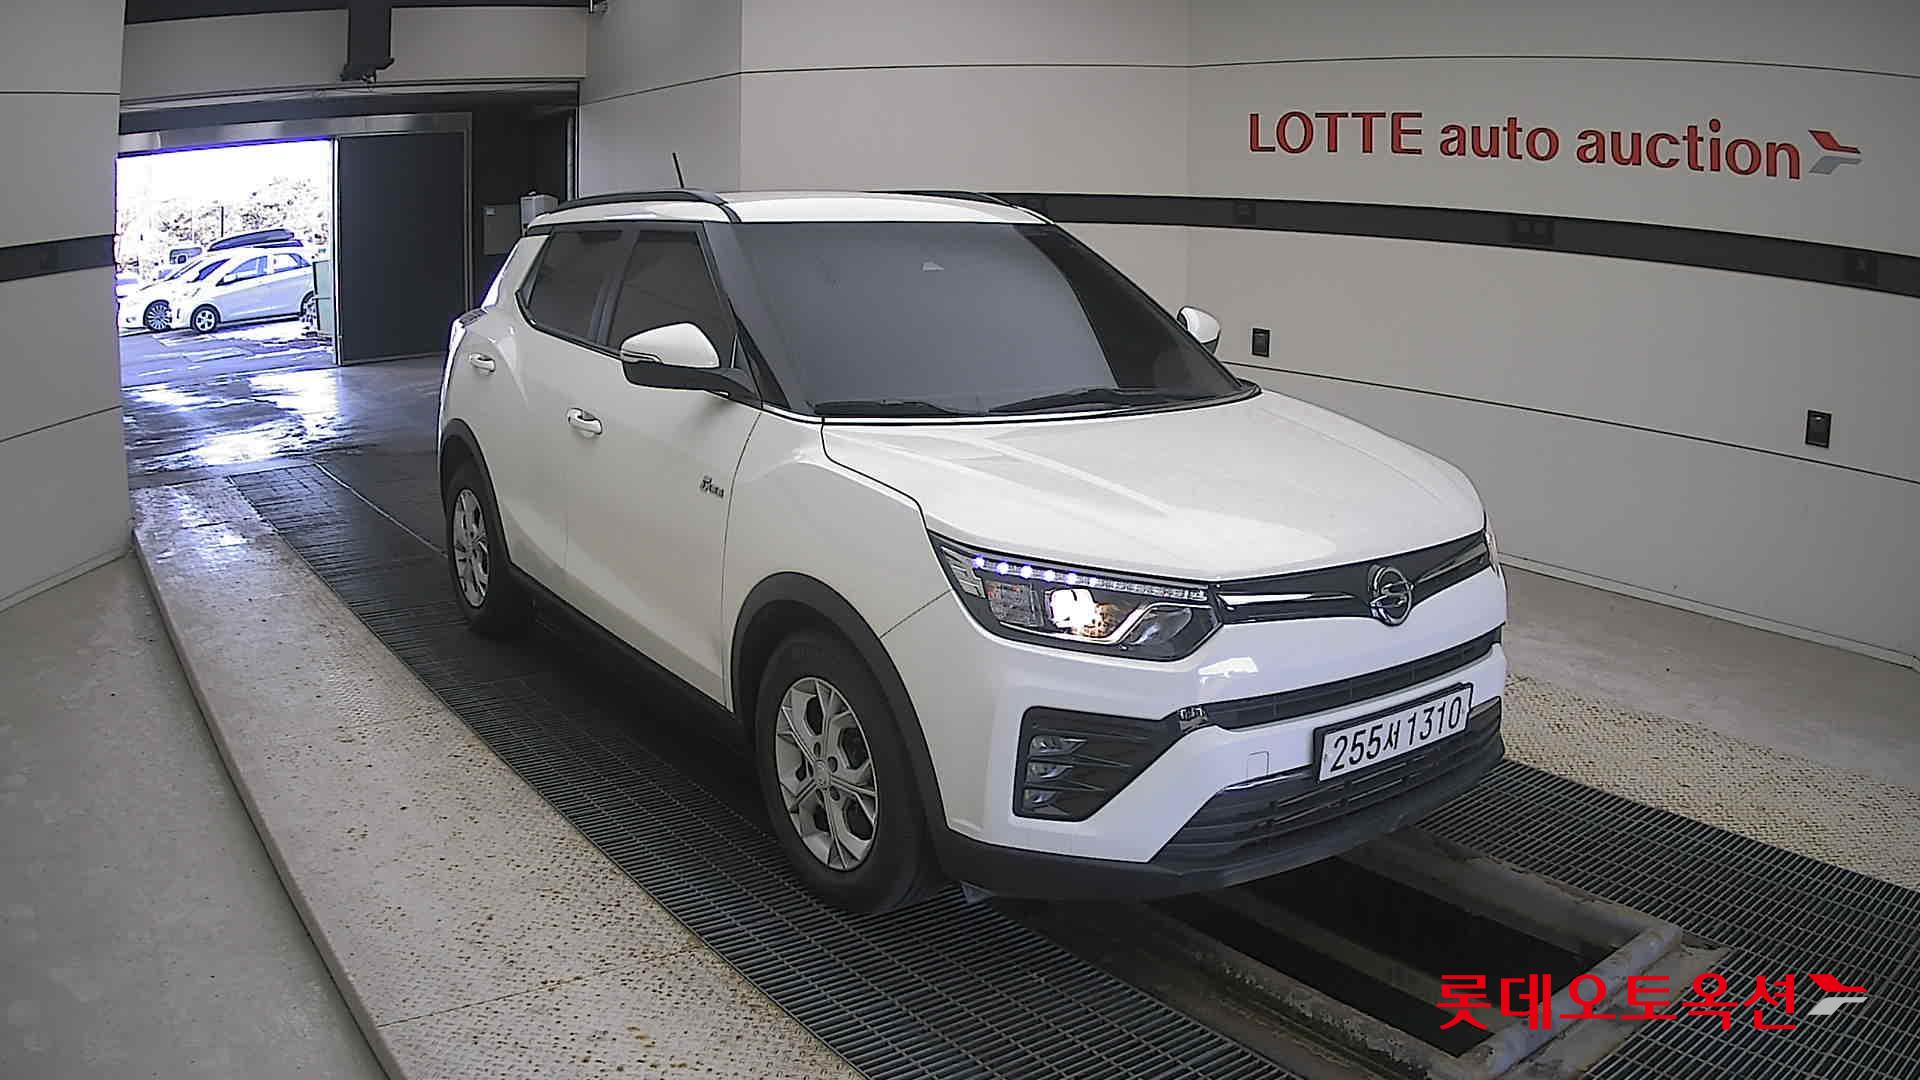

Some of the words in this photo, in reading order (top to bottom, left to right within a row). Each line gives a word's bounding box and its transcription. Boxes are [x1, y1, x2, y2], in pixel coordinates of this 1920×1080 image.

[1248, 111, 1423, 155] LOTTE
[1439, 117, 1559, 160] auto
[1576, 119, 1801, 179] auction
